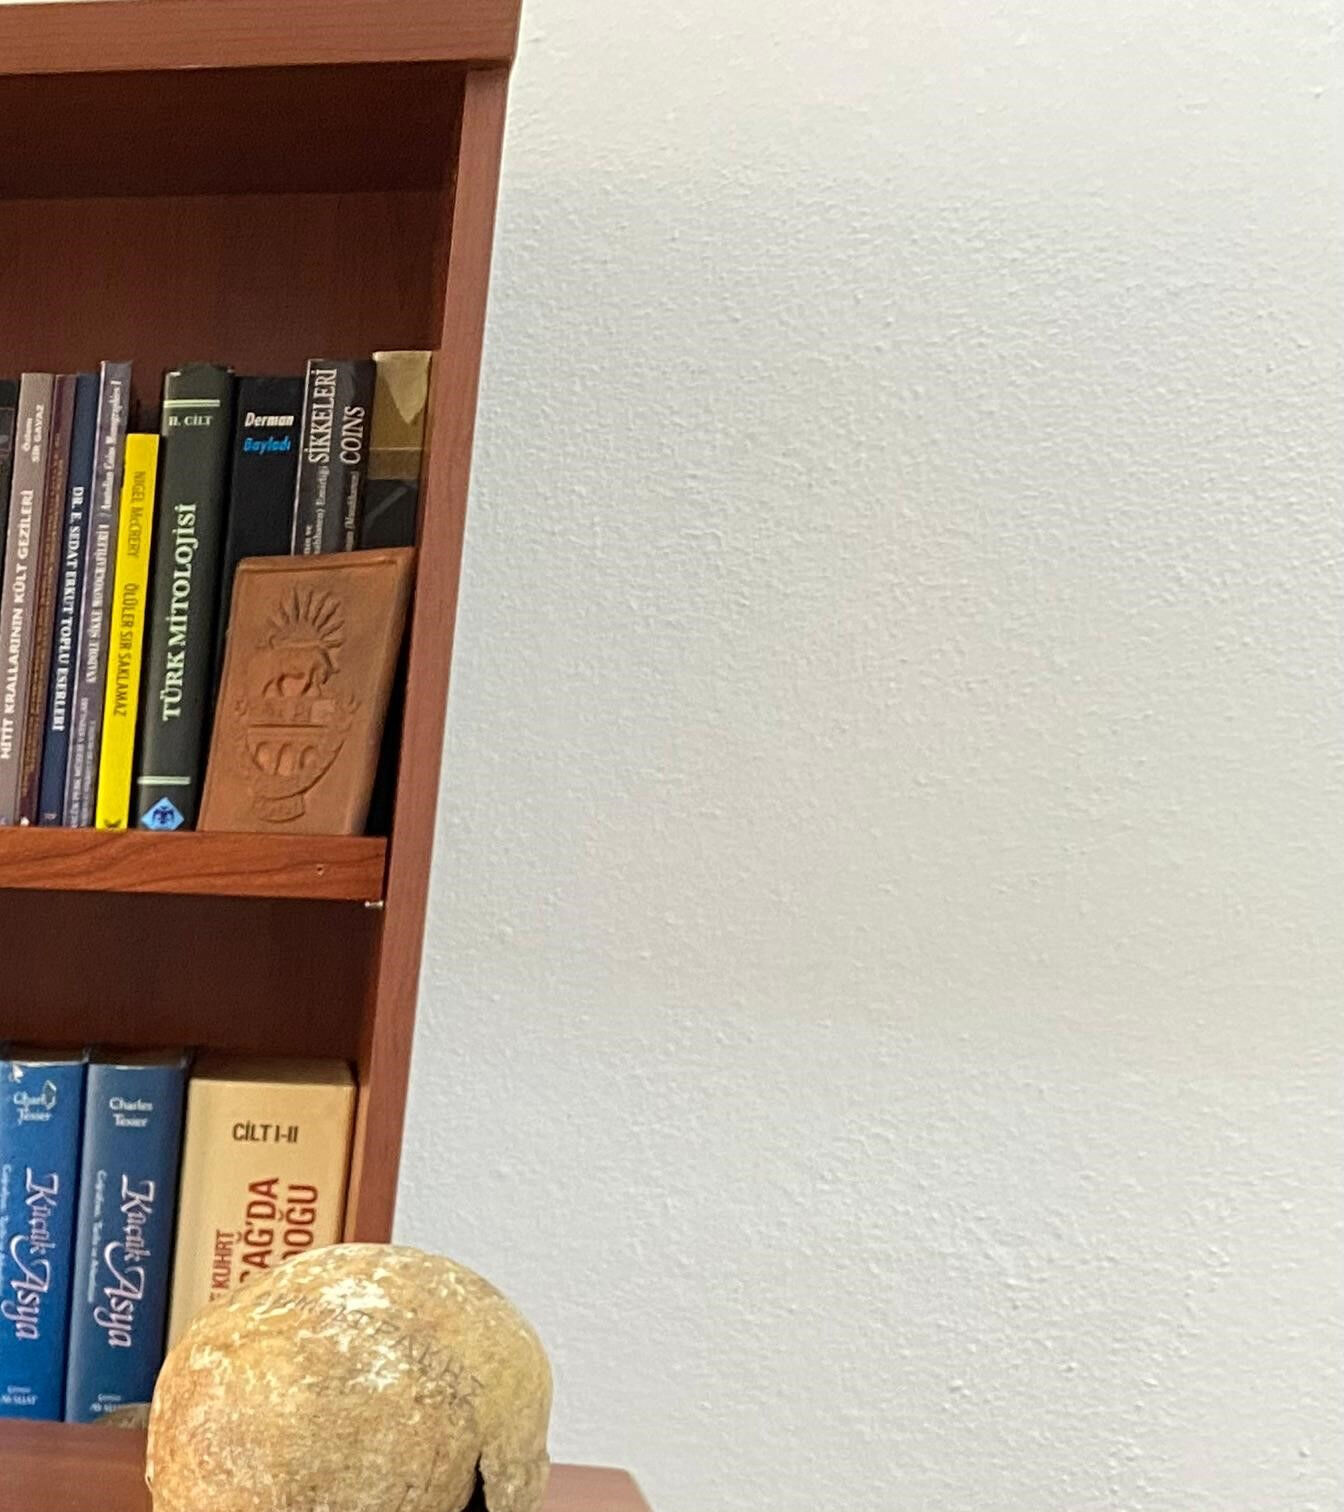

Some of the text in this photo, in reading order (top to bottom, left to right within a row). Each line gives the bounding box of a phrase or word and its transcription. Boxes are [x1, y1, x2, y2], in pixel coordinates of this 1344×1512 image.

[244, 411, 295, 427] Derman
[304, 367, 338, 464] SİKKELERİ
[339, 405, 366, 465] COINS
[17, 489, 33, 559] GEZİLERİ
[12, 563, 27, 603] KÜLT
[159, 504, 197, 720] TÜRK MİTOLOJİSİ
[4, 607, 22, 713] KRALLARININ
[108, 1096, 154, 1112] Charles
[232, 1119, 300, 1144] CİLT I-II
[274, 1184, 319, 1259] OĞU
[0, 1234, 51, 1340] Asya
[94, 1241, 146, 1348] Asya
[210, 1229, 236, 1290] KUHRT
